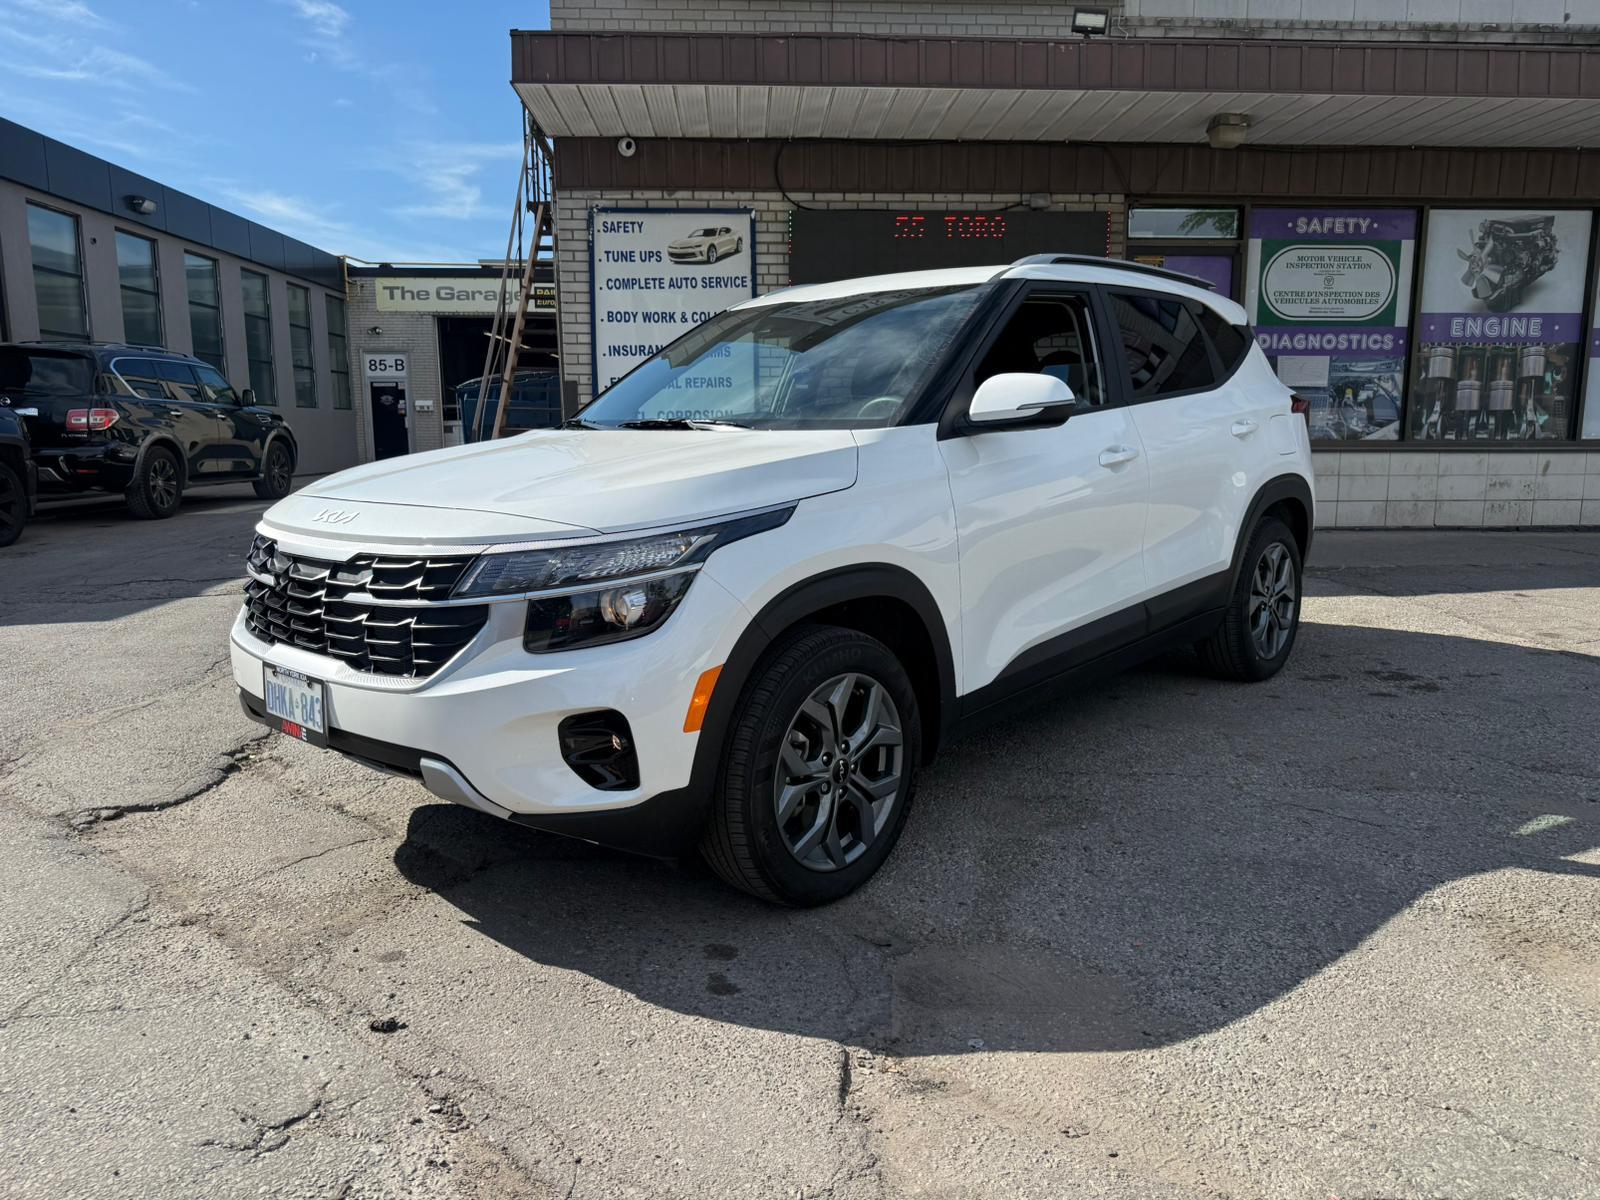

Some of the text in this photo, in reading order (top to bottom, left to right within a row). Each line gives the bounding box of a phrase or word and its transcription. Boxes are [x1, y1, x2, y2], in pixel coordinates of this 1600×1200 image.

[602, 221, 644, 233] SAFETY
[944, 216, 1006, 238] TORO
[1296, 217, 1371, 234] SAFETY
[605, 250, 662, 262] TUNE UPS
[606, 276, 748, 290] COMPLETE AUTO SERVICE
[382, 286, 430, 301] The
[607, 312, 637, 324] BODY
[641, 311, 676, 323] WORK
[680, 311, 688, 323] &
[1450, 317, 1543, 338] ENGINE
[1257, 333, 1394, 350] DIAGNOSTICS
[368, 359, 405, 371] 85-B
[685, 376, 732, 389] REPAIRS
[312, 508, 360, 524] KIA
